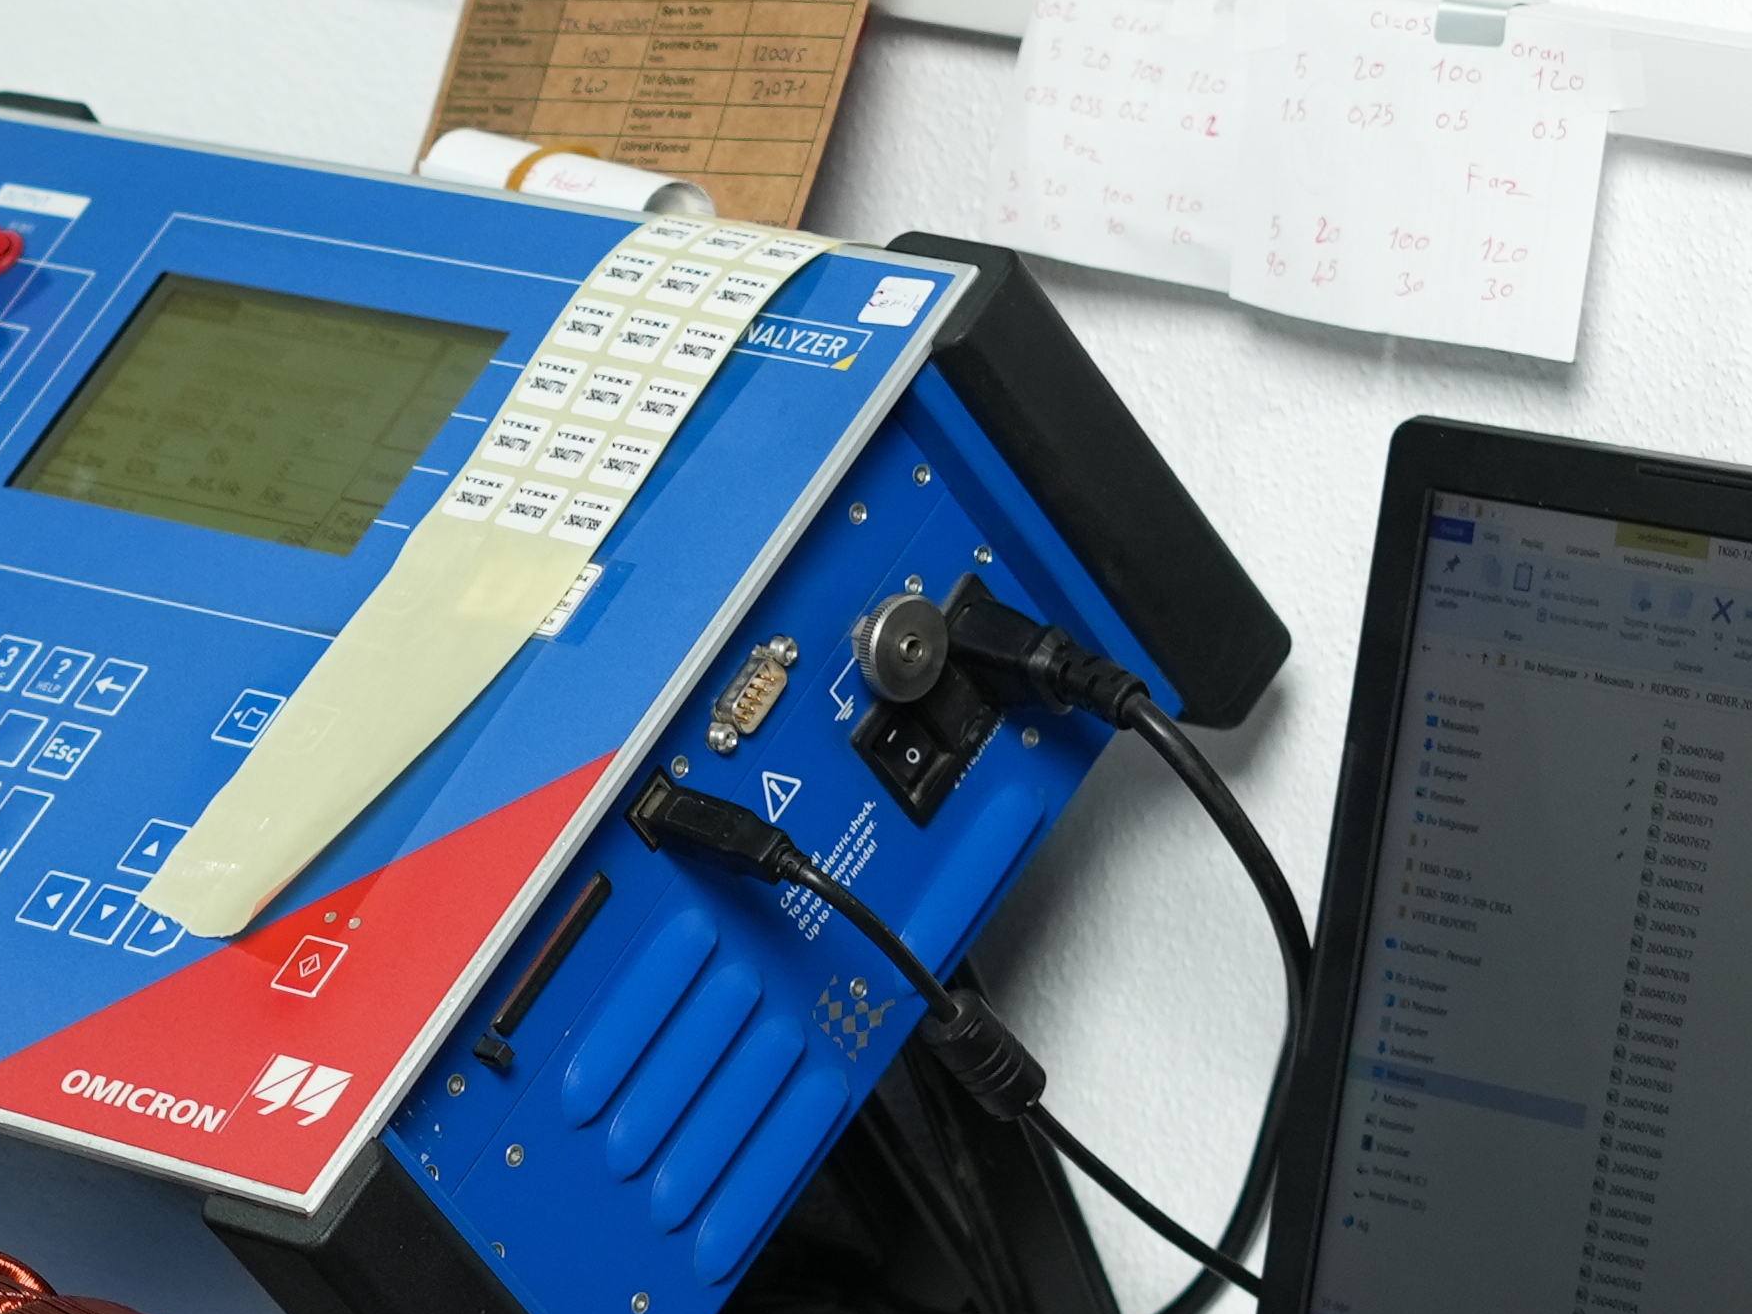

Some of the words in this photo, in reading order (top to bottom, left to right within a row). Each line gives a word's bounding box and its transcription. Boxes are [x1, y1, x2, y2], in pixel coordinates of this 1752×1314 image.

[1511, 43, 1565, 65] oran
[1295, 52, 1307, 79] 5
[1353, 54, 1385, 81] 20
[1430, 57, 1483, 84] 100
[1531, 66, 1585, 91] 120
[1465, 162, 1533, 198] Faz
[1269, 214, 1281, 241] 5
[1313, 216, 1342, 244] 20
[1388, 227, 1431, 251] 100
[1480, 235, 1529, 264] 120
[1395, 271, 1425, 297] 30
[1480, 277, 1514, 302] 30
[53, 658, 73, 680] ?
[42, 738, 81, 763] Esc
[788, 904, 802, 919] To
[821, 834, 851, 874] electric
[797, 913, 810, 931] do
[804, 923, 820, 941] Up
[59, 1068, 228, 1133] OMICRON
